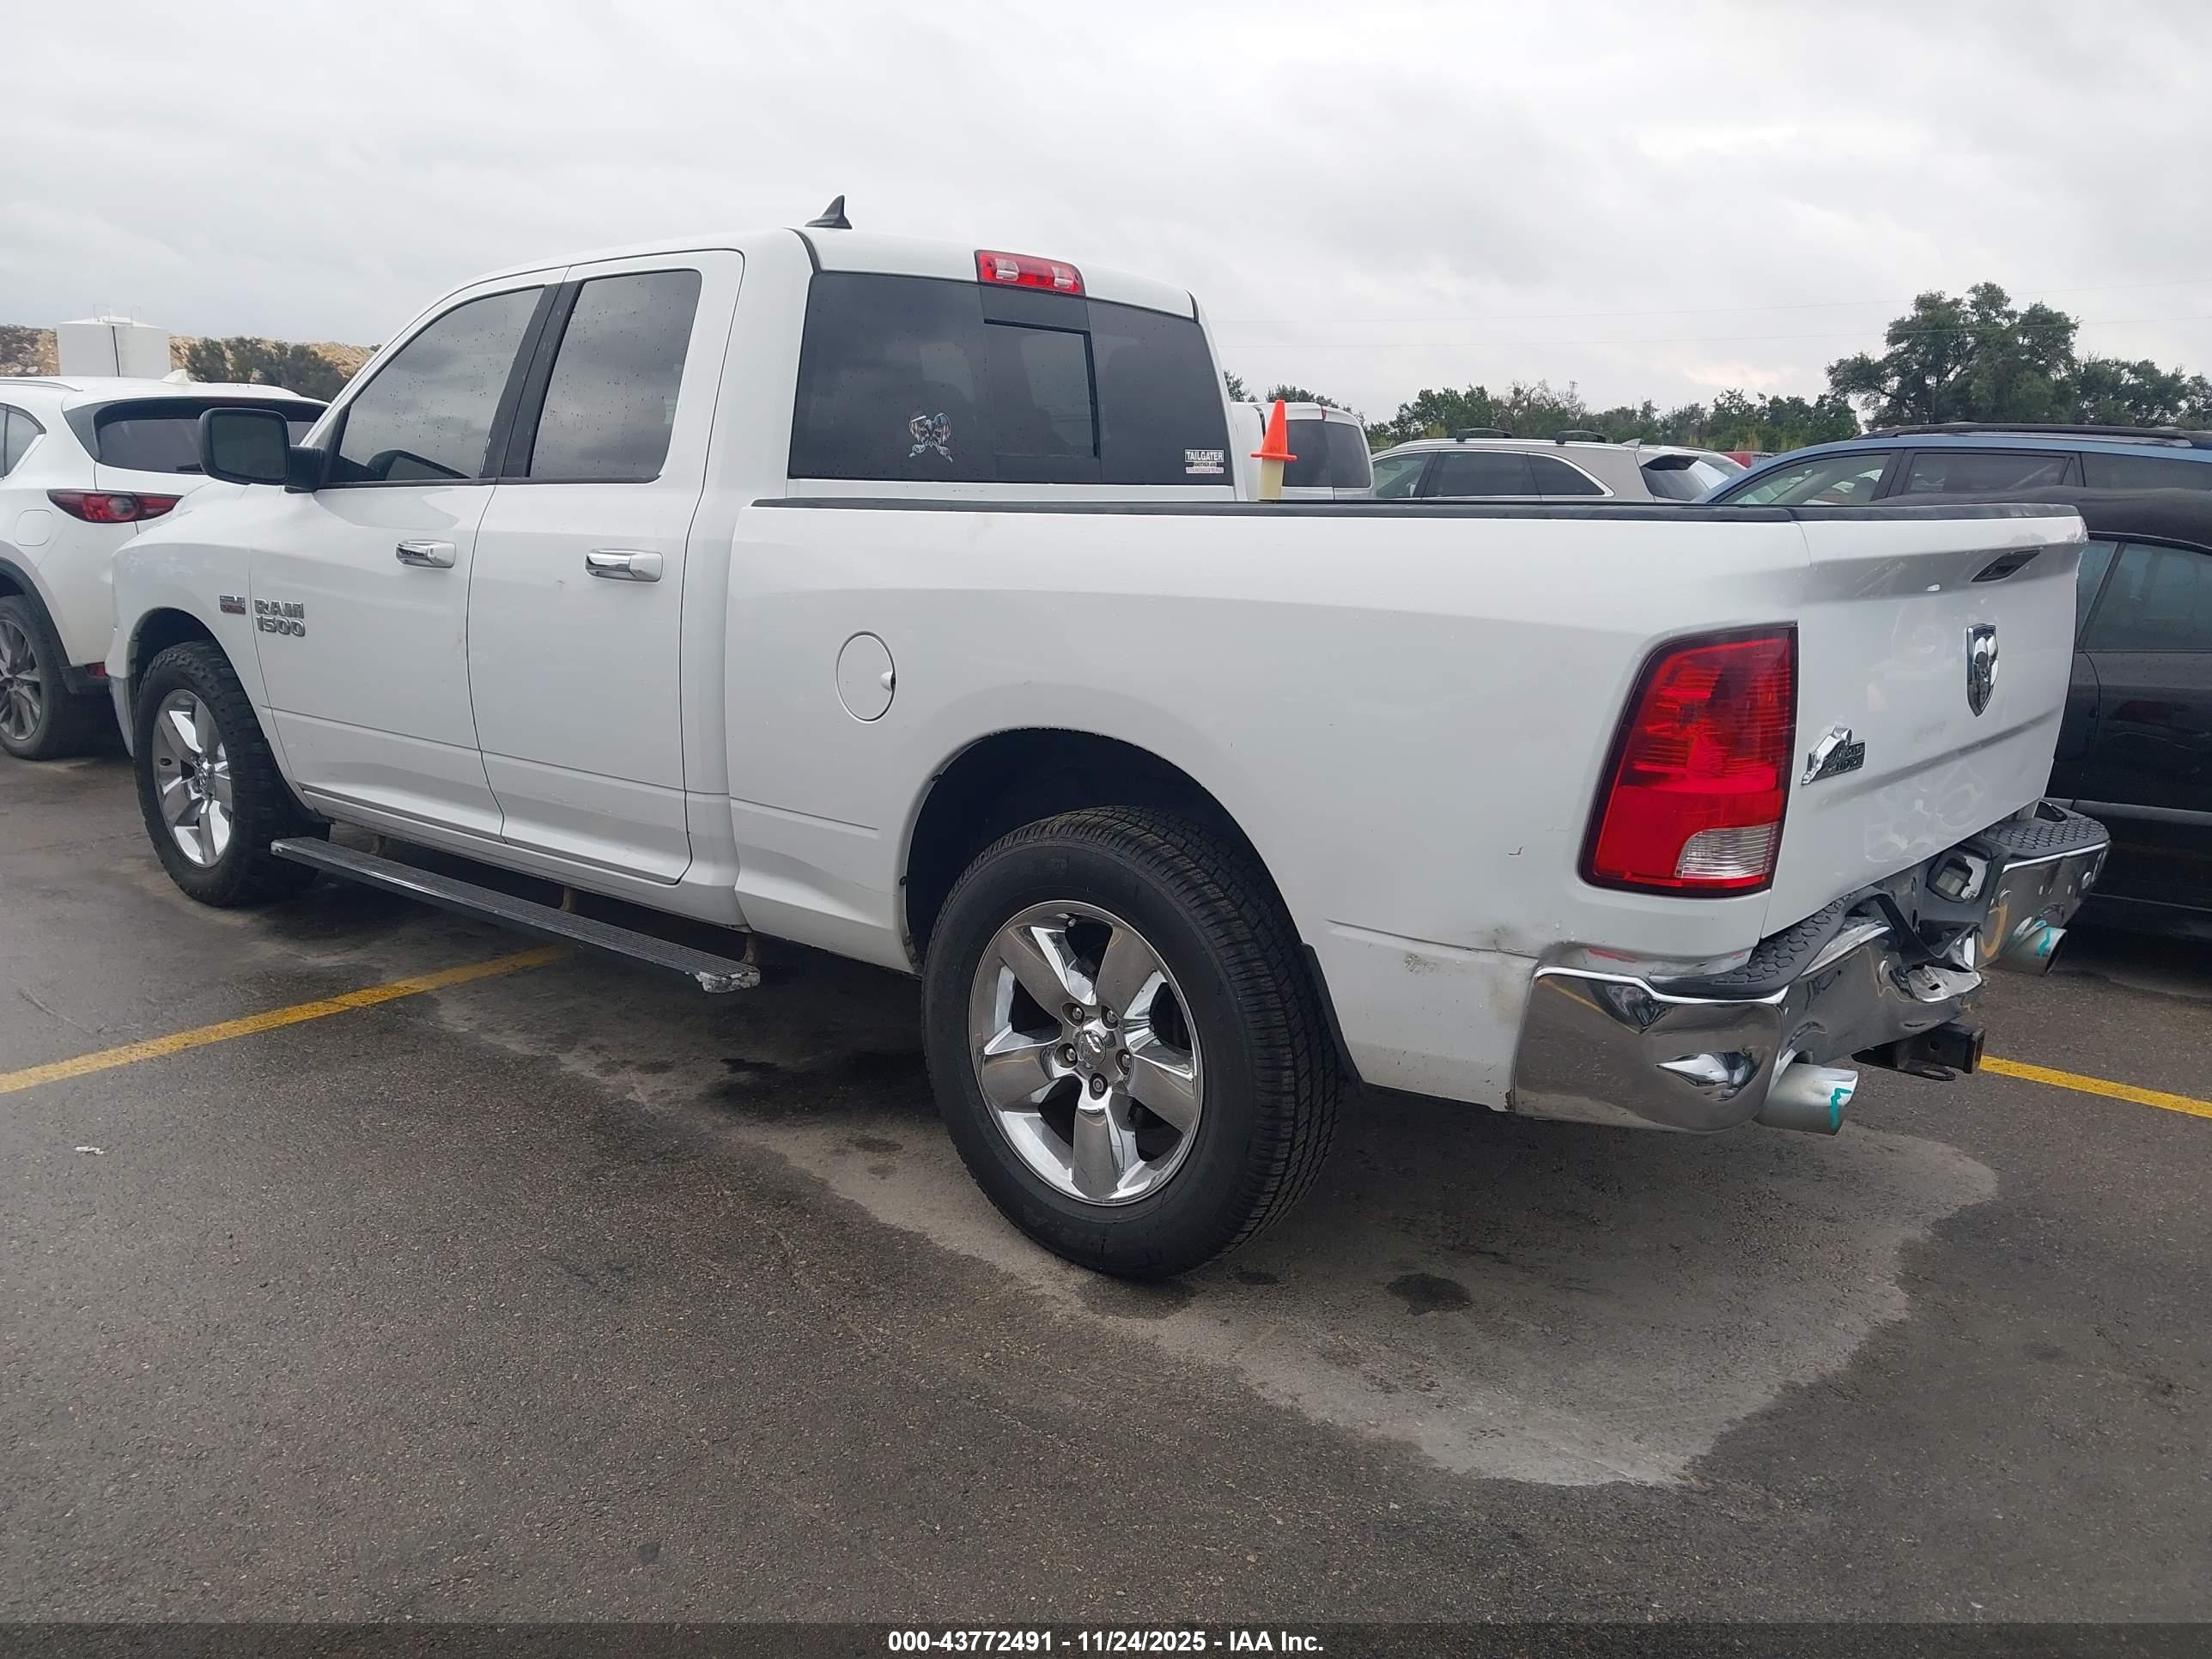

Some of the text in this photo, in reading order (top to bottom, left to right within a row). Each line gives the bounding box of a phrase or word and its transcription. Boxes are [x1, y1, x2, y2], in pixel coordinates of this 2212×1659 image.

[1186, 451, 1223, 461] TAILGATER
[254, 599, 305, 619] RAM
[256, 616, 306, 637] 1500
